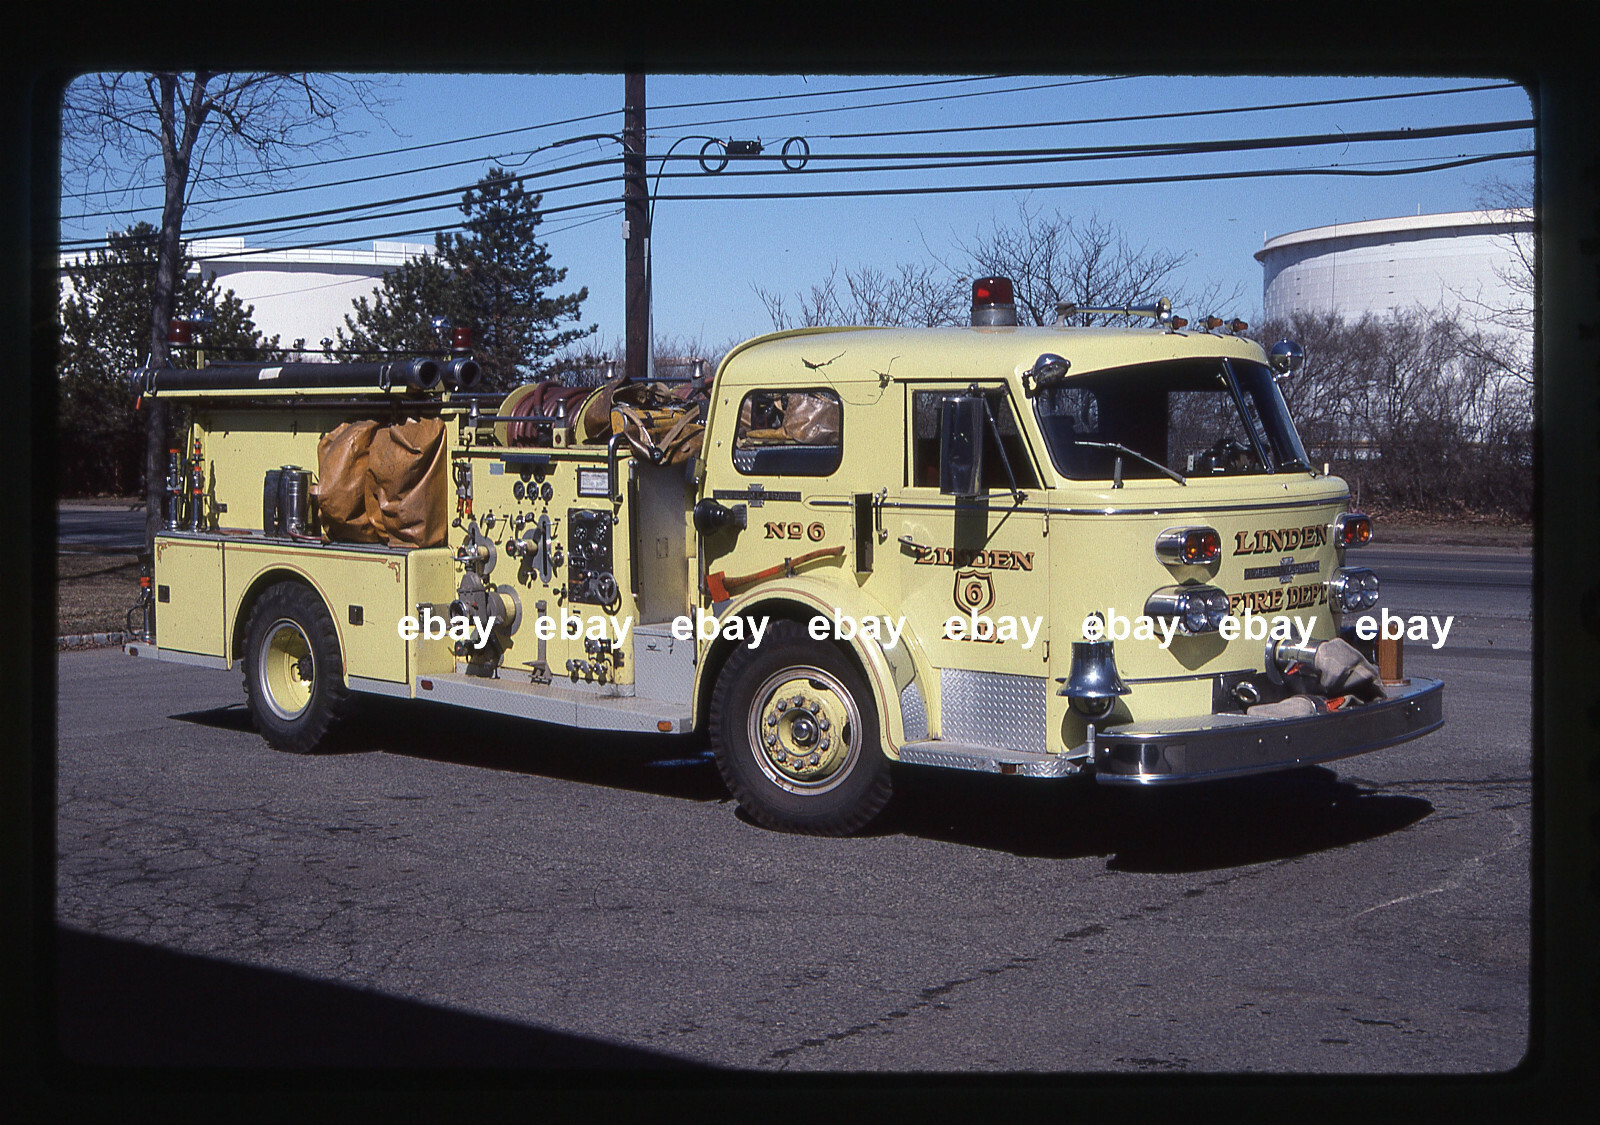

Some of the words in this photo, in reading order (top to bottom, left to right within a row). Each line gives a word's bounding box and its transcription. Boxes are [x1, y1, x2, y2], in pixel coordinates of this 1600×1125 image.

[807, 521, 826, 542] 6
[1232, 522, 1328, 556] LINDEN
[964, 581, 984, 606] 6
[1228, 588, 1284, 617] FIRE
